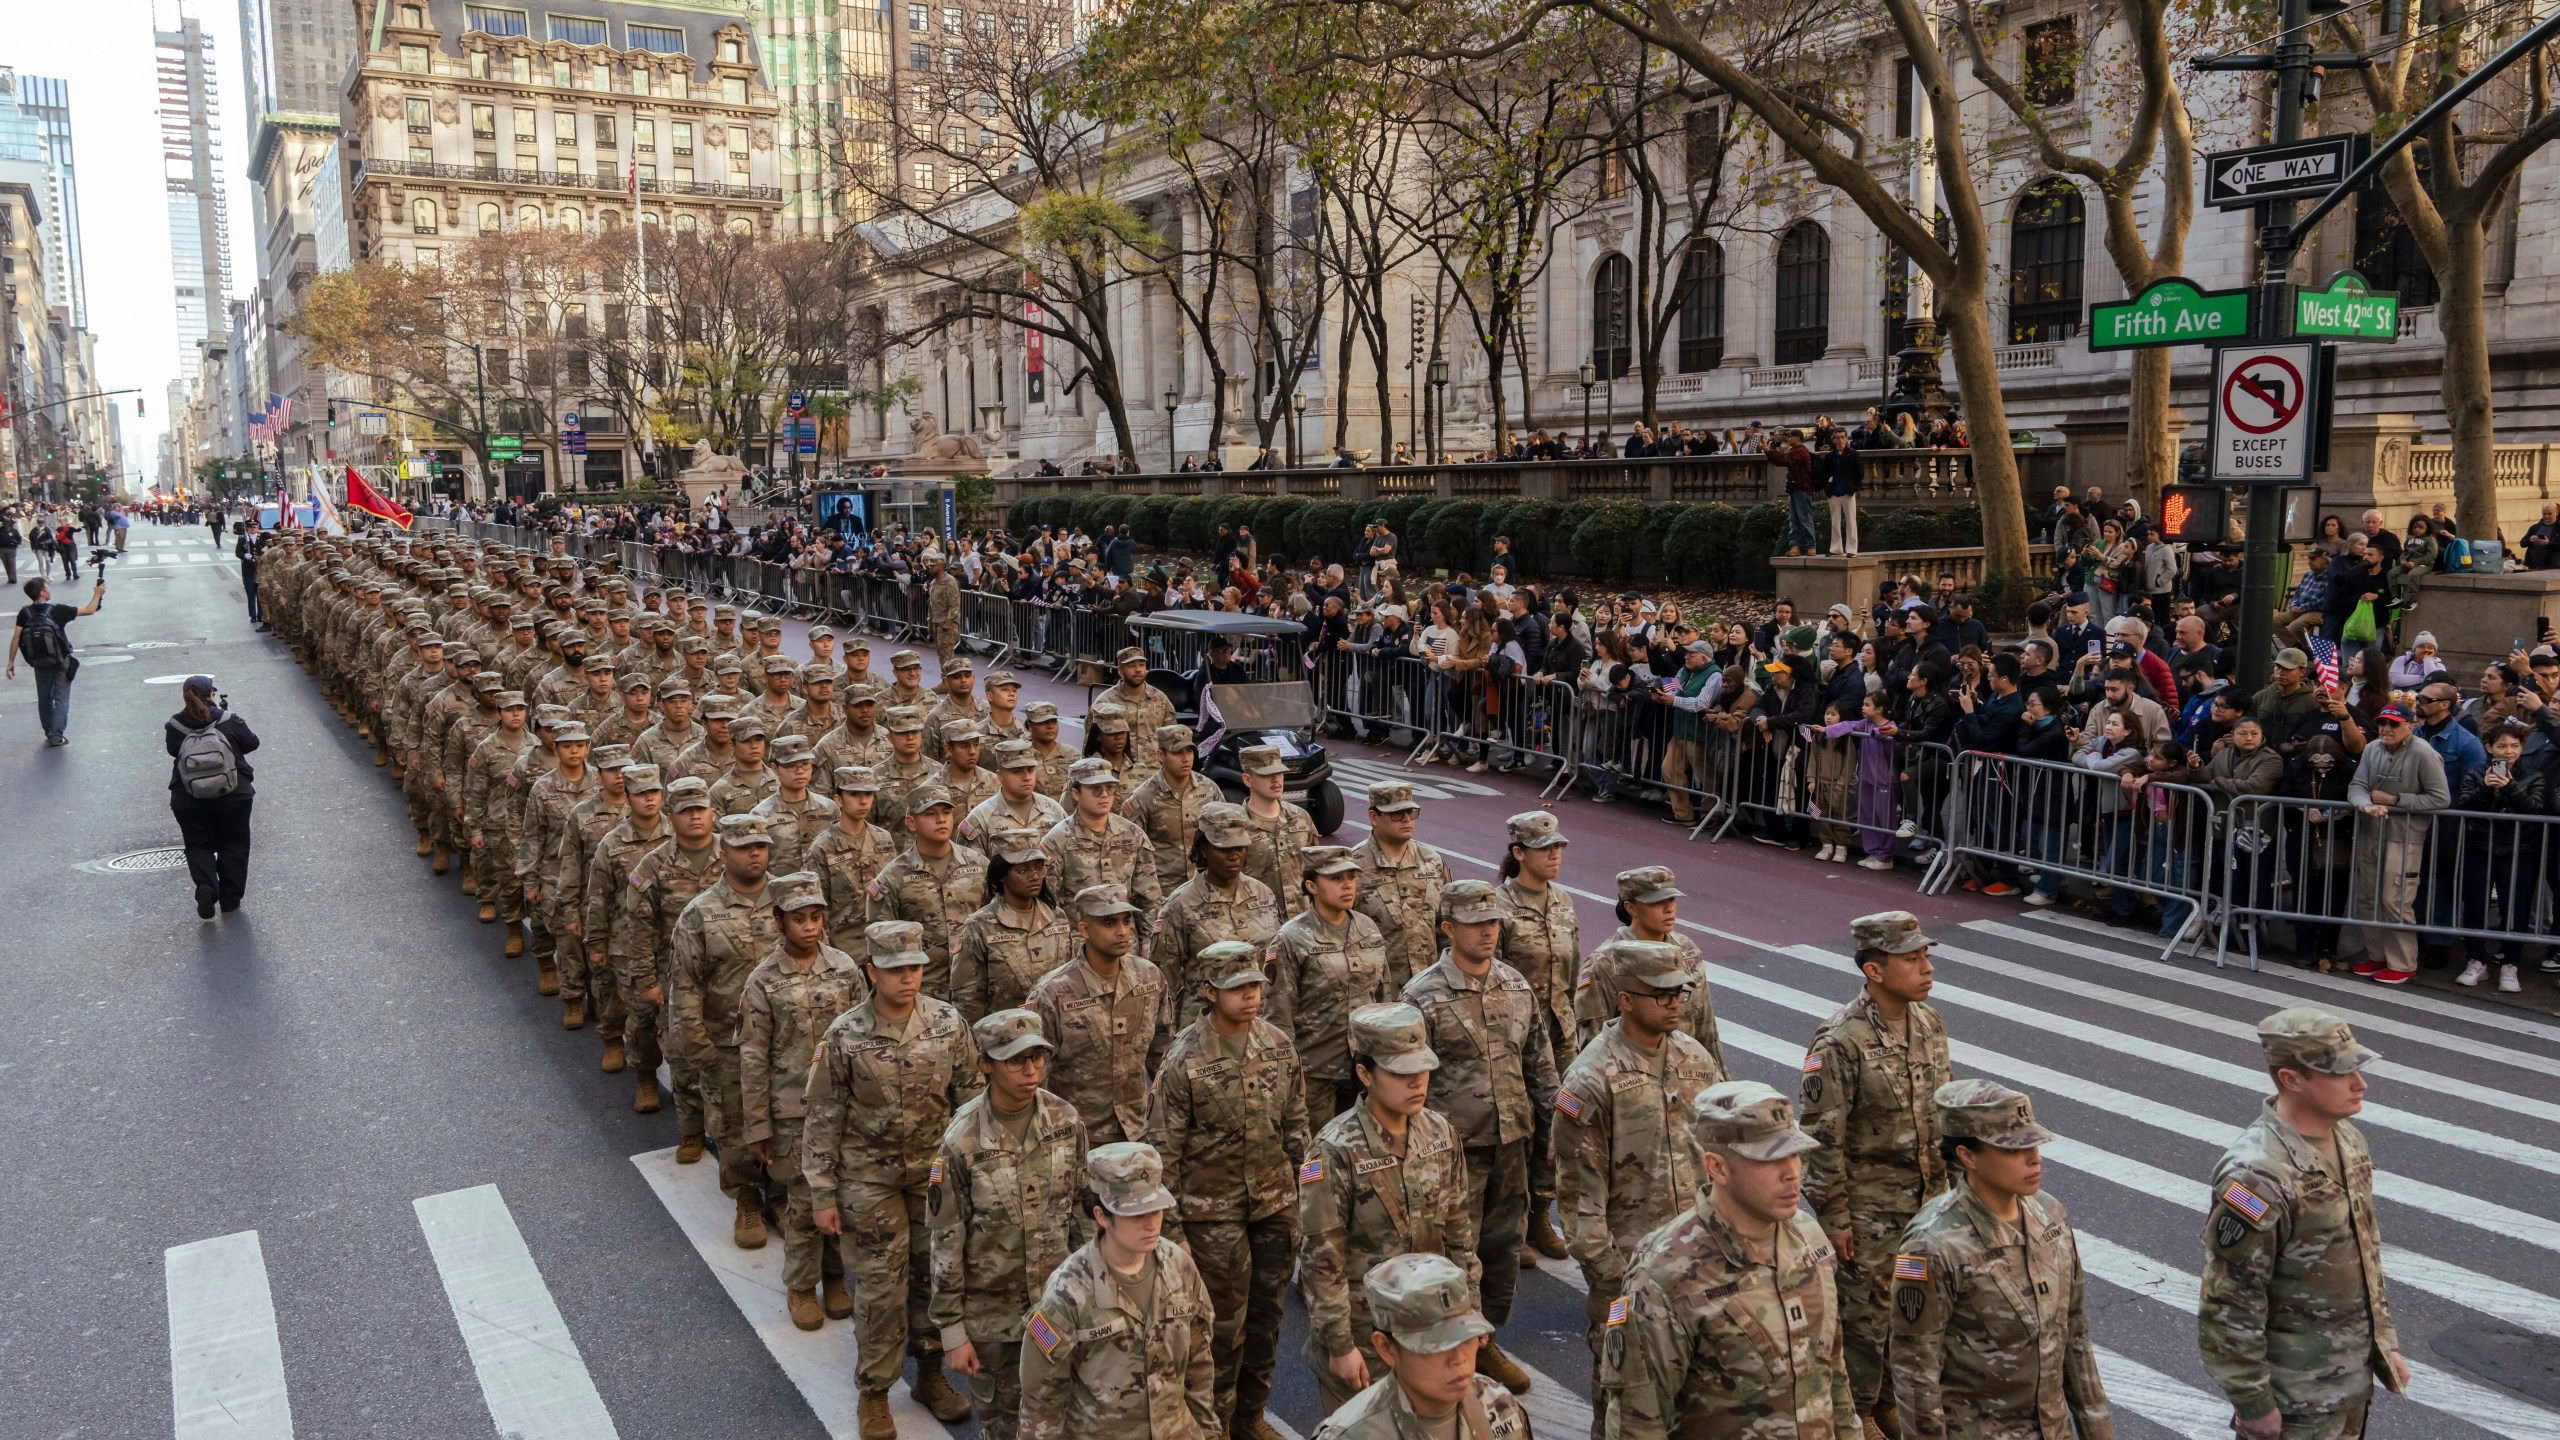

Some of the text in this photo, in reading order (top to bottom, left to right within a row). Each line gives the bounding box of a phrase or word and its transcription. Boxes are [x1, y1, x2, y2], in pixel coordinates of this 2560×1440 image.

[2232, 157, 2325, 185] ONE WAY
[2303, 300, 2391, 330] West 42nd St
[2114, 309, 2222, 338] Fifth Ave
[2232, 439, 2287, 452] EXCEPT
[2235, 455, 2282, 468] BUSES
[991, 934, 1016, 942] JOHNSON
[772, 980, 793, 991] GRANT
[935, 1025, 952, 1035] ARMY
[1265, 1049, 1290, 1059] U.S. ARMY
[1867, 1046, 1895, 1059] GONZAGA
[1195, 1063, 1223, 1077] TORRES
[1682, 1070, 1710, 1079] U.S. ARMY
[1618, 1077, 1644, 1090] RAHMAN
[1053, 1126, 1072, 1139] ARMY
[1432, 1140, 1448, 1152] ARMY
[973, 1150, 1001, 1163] BURGOS
[1815, 1245, 1831, 1260] ARMY
[1172, 1306, 1186, 1316] U.S.
[1089, 1324, 1112, 1339] SHAW
